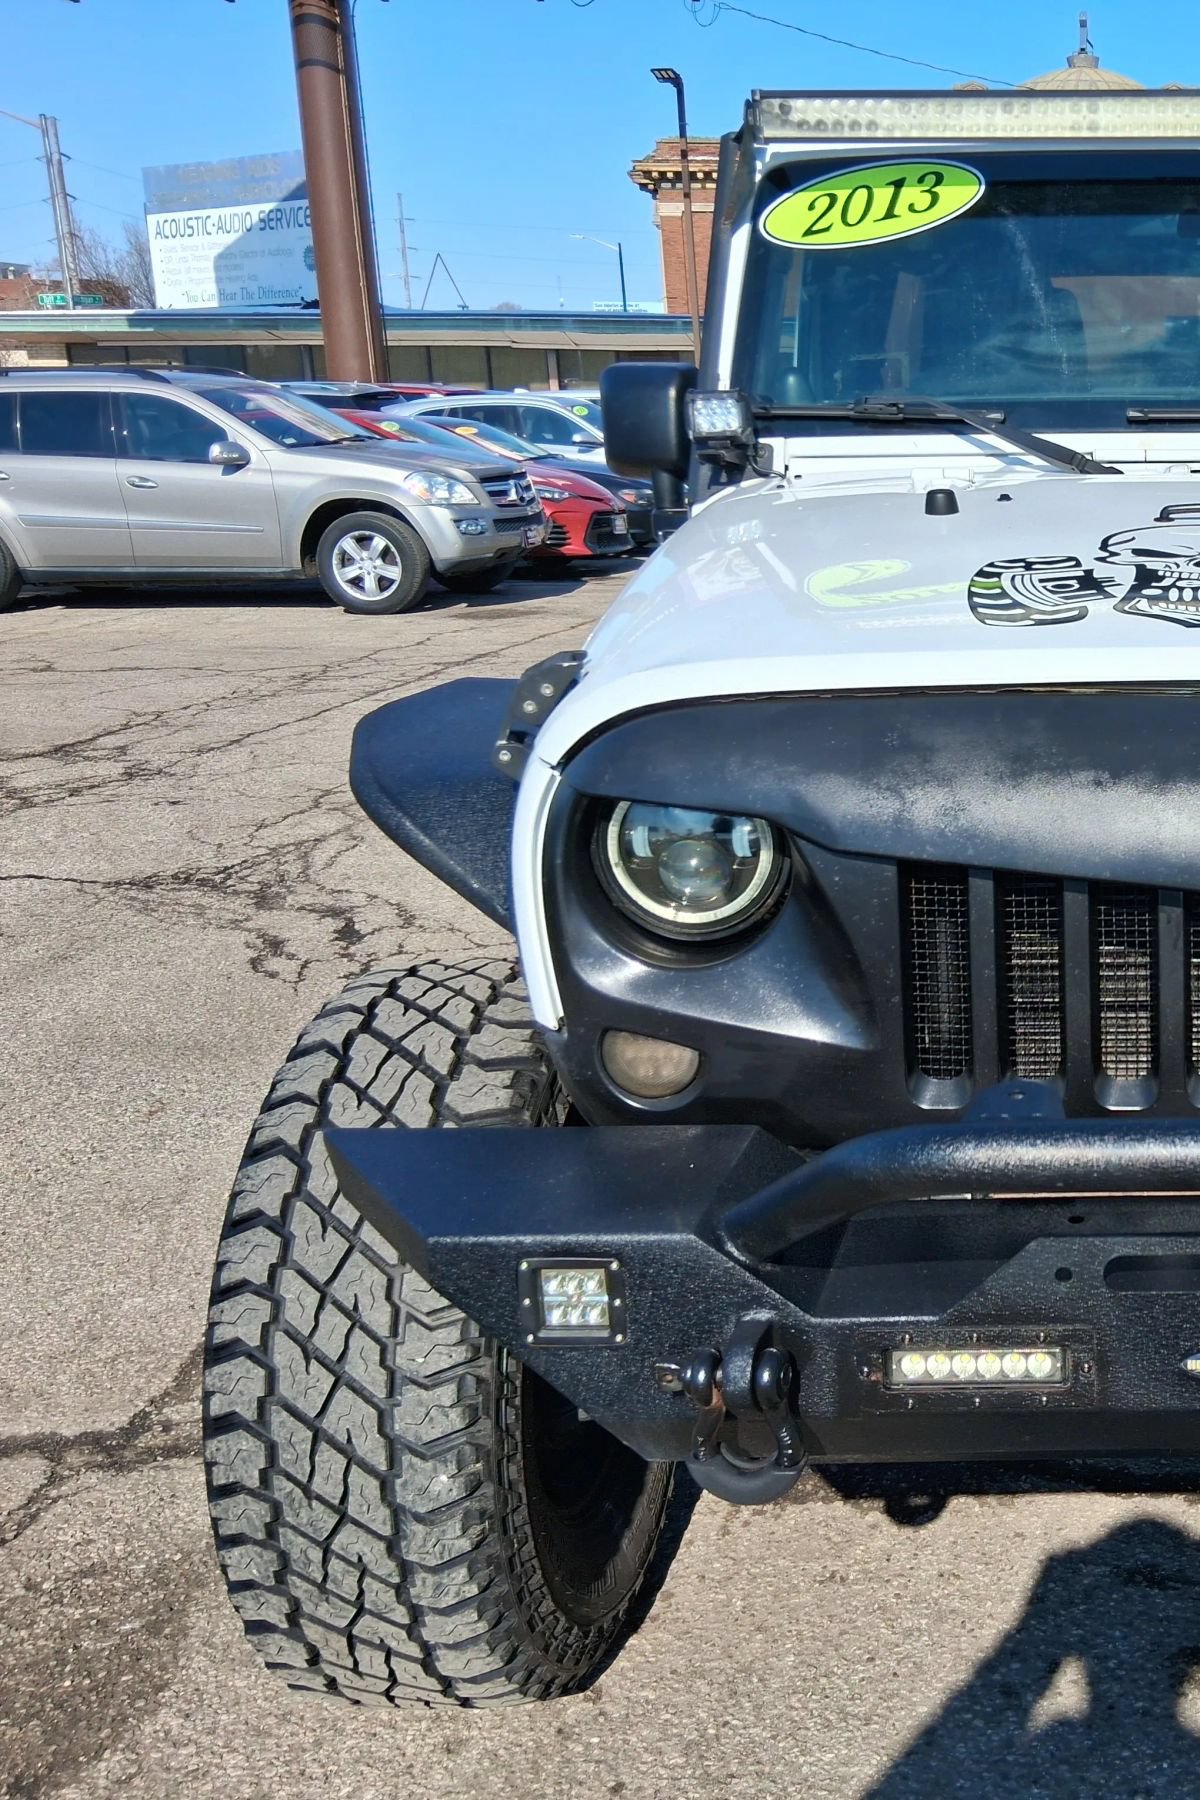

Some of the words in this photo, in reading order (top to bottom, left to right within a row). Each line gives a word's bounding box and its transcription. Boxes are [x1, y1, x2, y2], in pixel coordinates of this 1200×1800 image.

[801, 171, 944, 238] 2013
[219, 288, 237, 301] Hear
[240, 287, 256, 301] The
